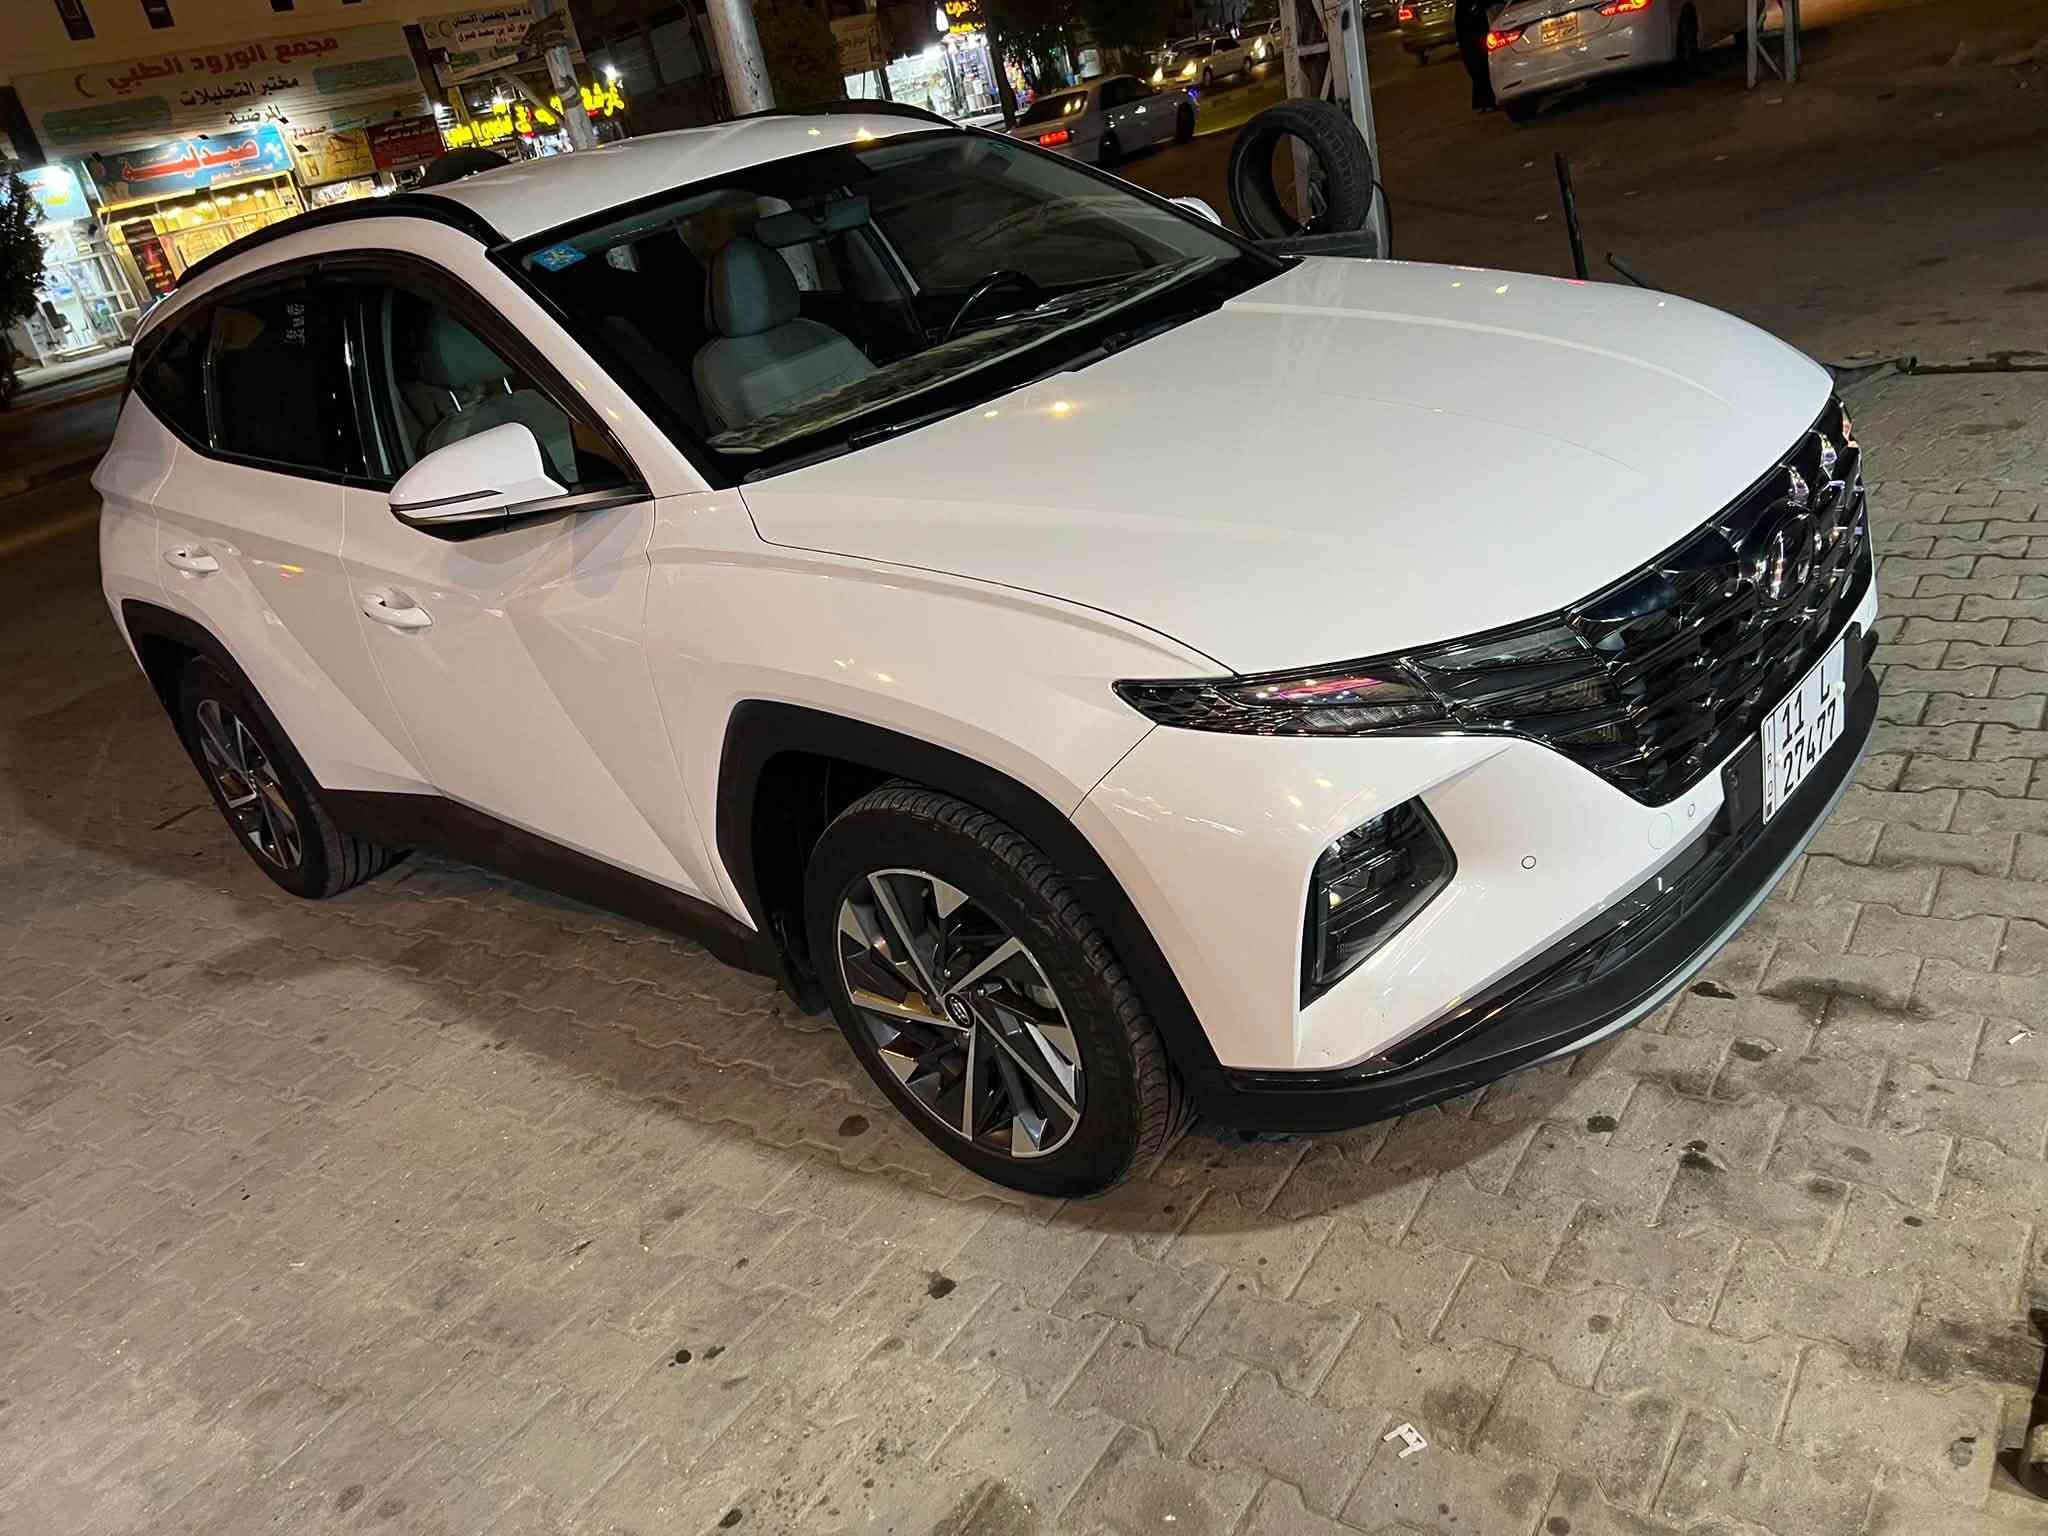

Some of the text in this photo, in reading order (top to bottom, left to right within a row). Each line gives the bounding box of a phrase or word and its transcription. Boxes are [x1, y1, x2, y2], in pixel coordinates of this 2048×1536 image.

[108, 37, 338, 94] مجمع الورود الطبي
[121, 137, 261, 183] صيدلية
[1782, 665, 1830, 749] 11 L
[1783, 698, 1836, 798] 27477
